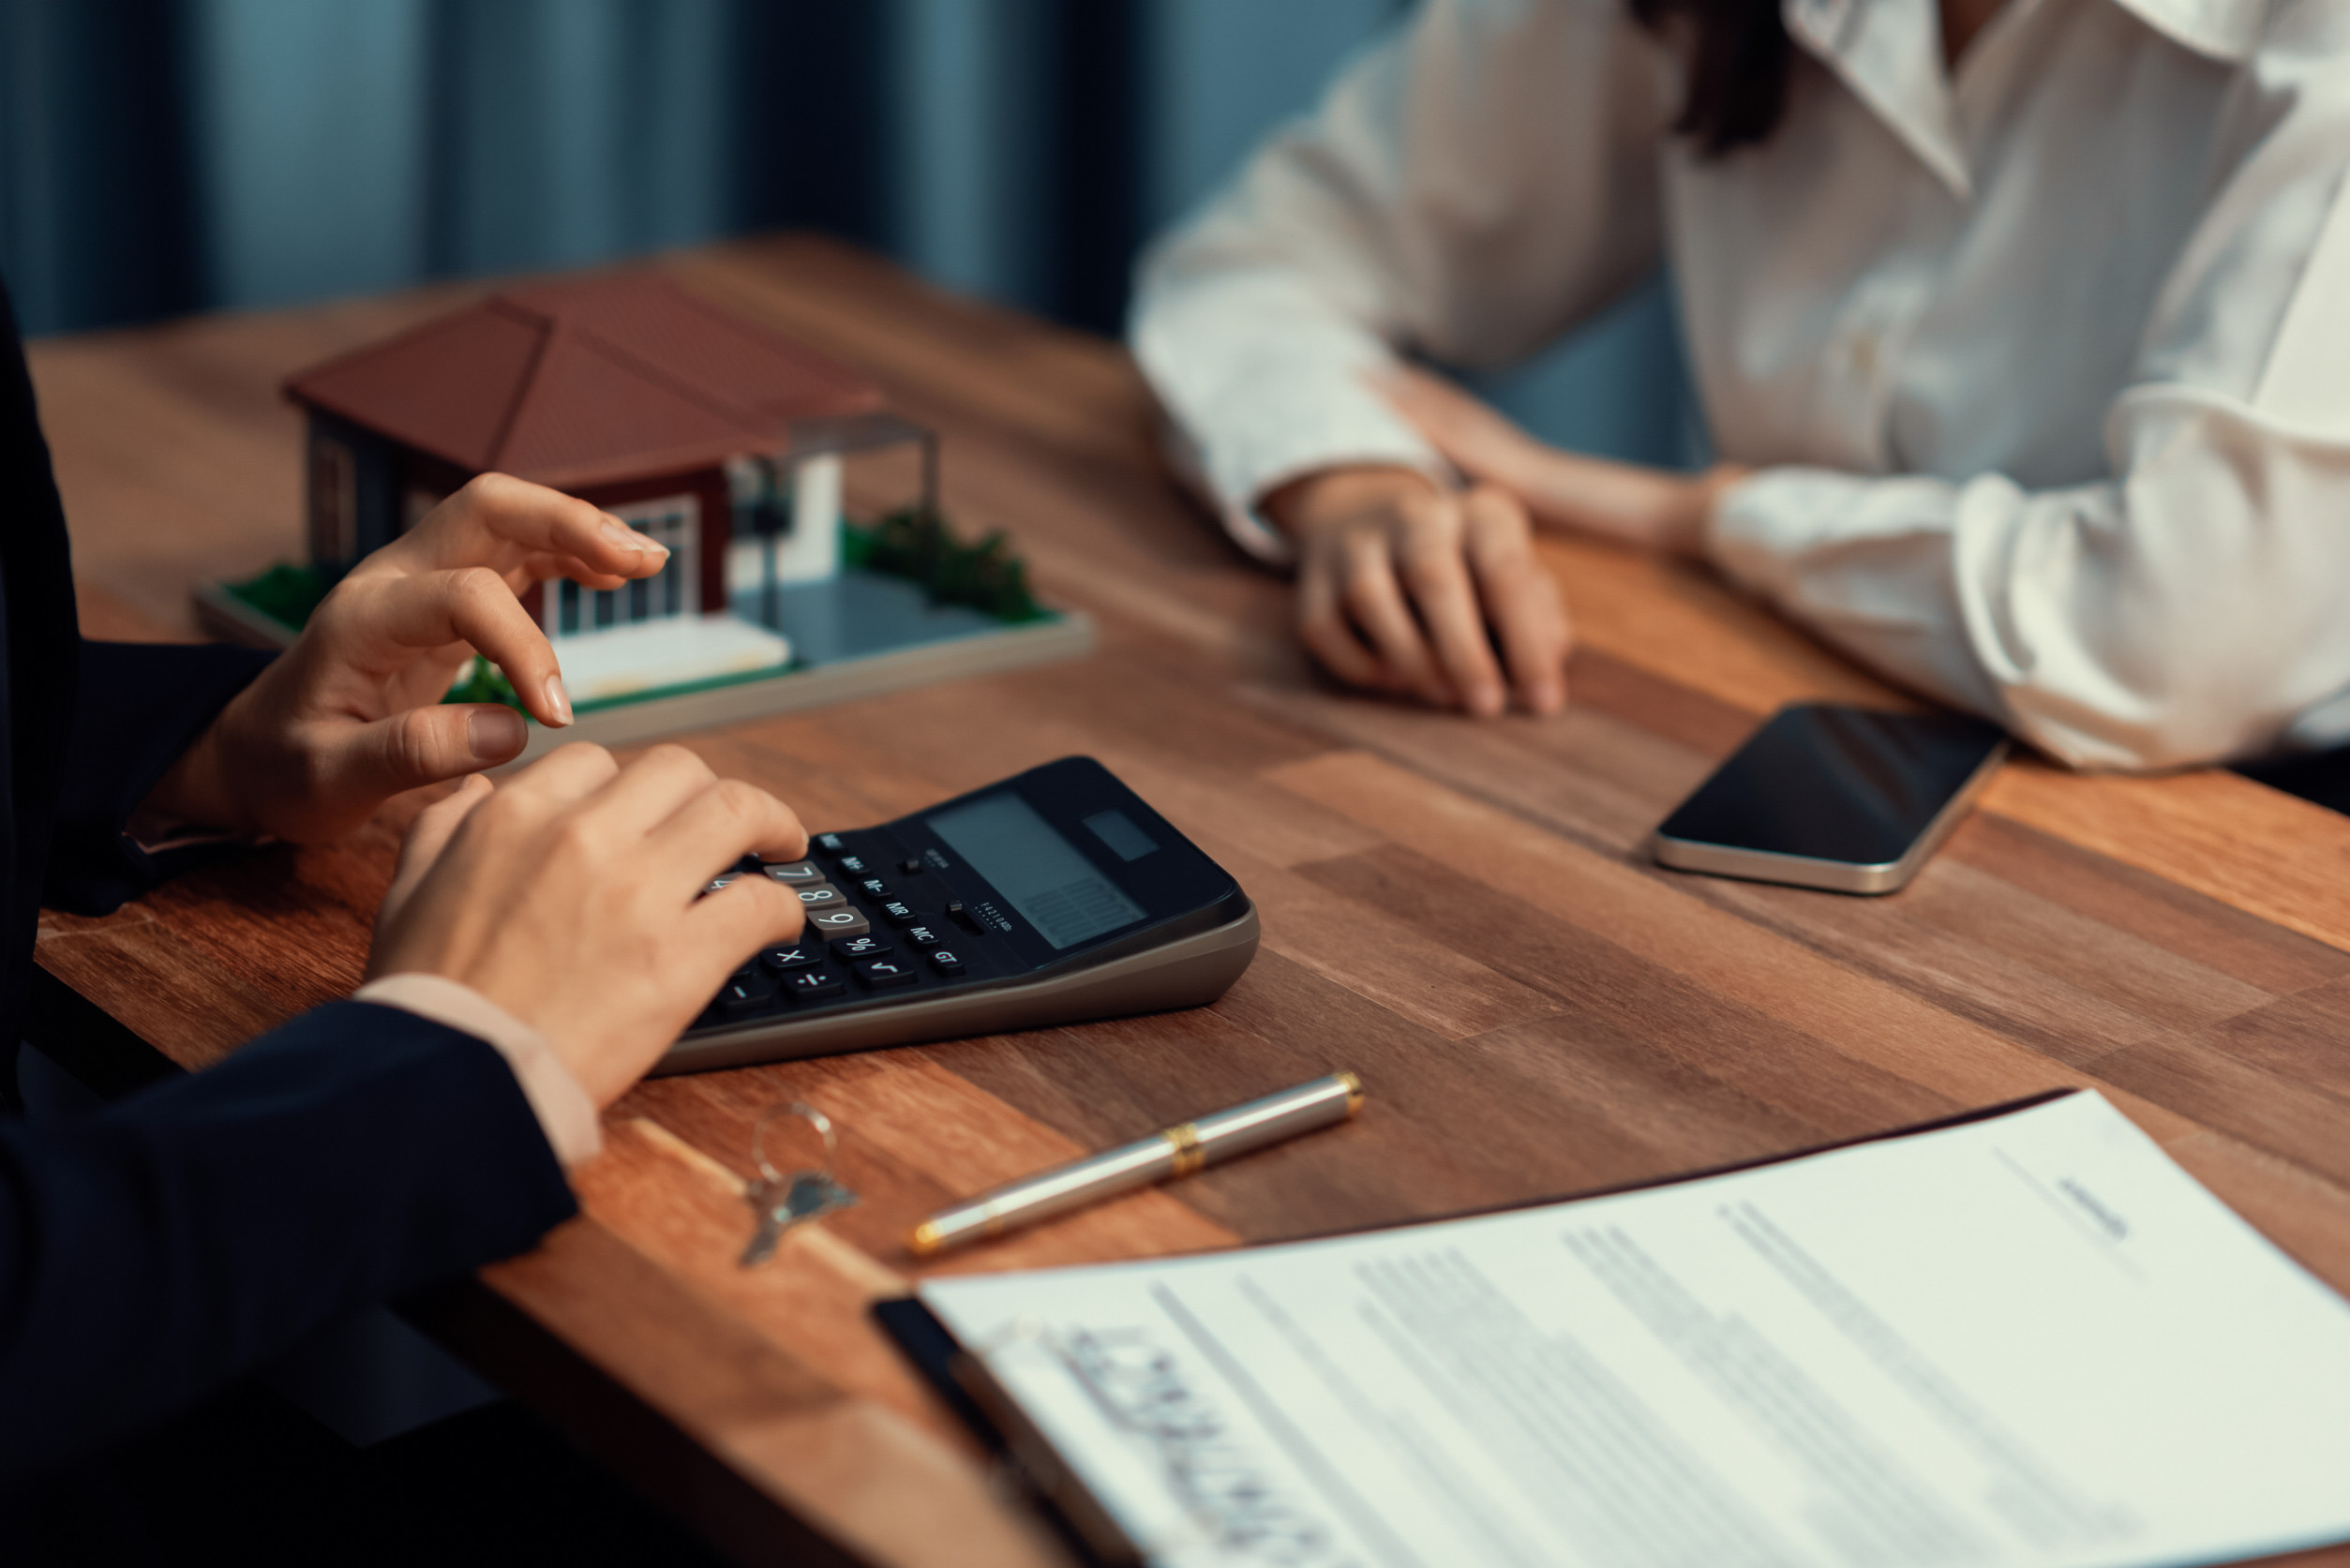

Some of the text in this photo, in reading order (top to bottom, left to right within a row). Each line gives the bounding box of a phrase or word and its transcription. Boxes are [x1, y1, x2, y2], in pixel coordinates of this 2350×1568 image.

[841, 857, 864, 870] M+
[776, 866, 813, 877] 7
[863, 879, 883, 892] M-
[798, 890, 833, 902] 8
[886, 902, 909, 916] MR
[818, 913, 854, 924] 9
[910, 927, 935, 941] MC
[846, 938, 876, 951] %
[935, 951, 957, 963] GT
